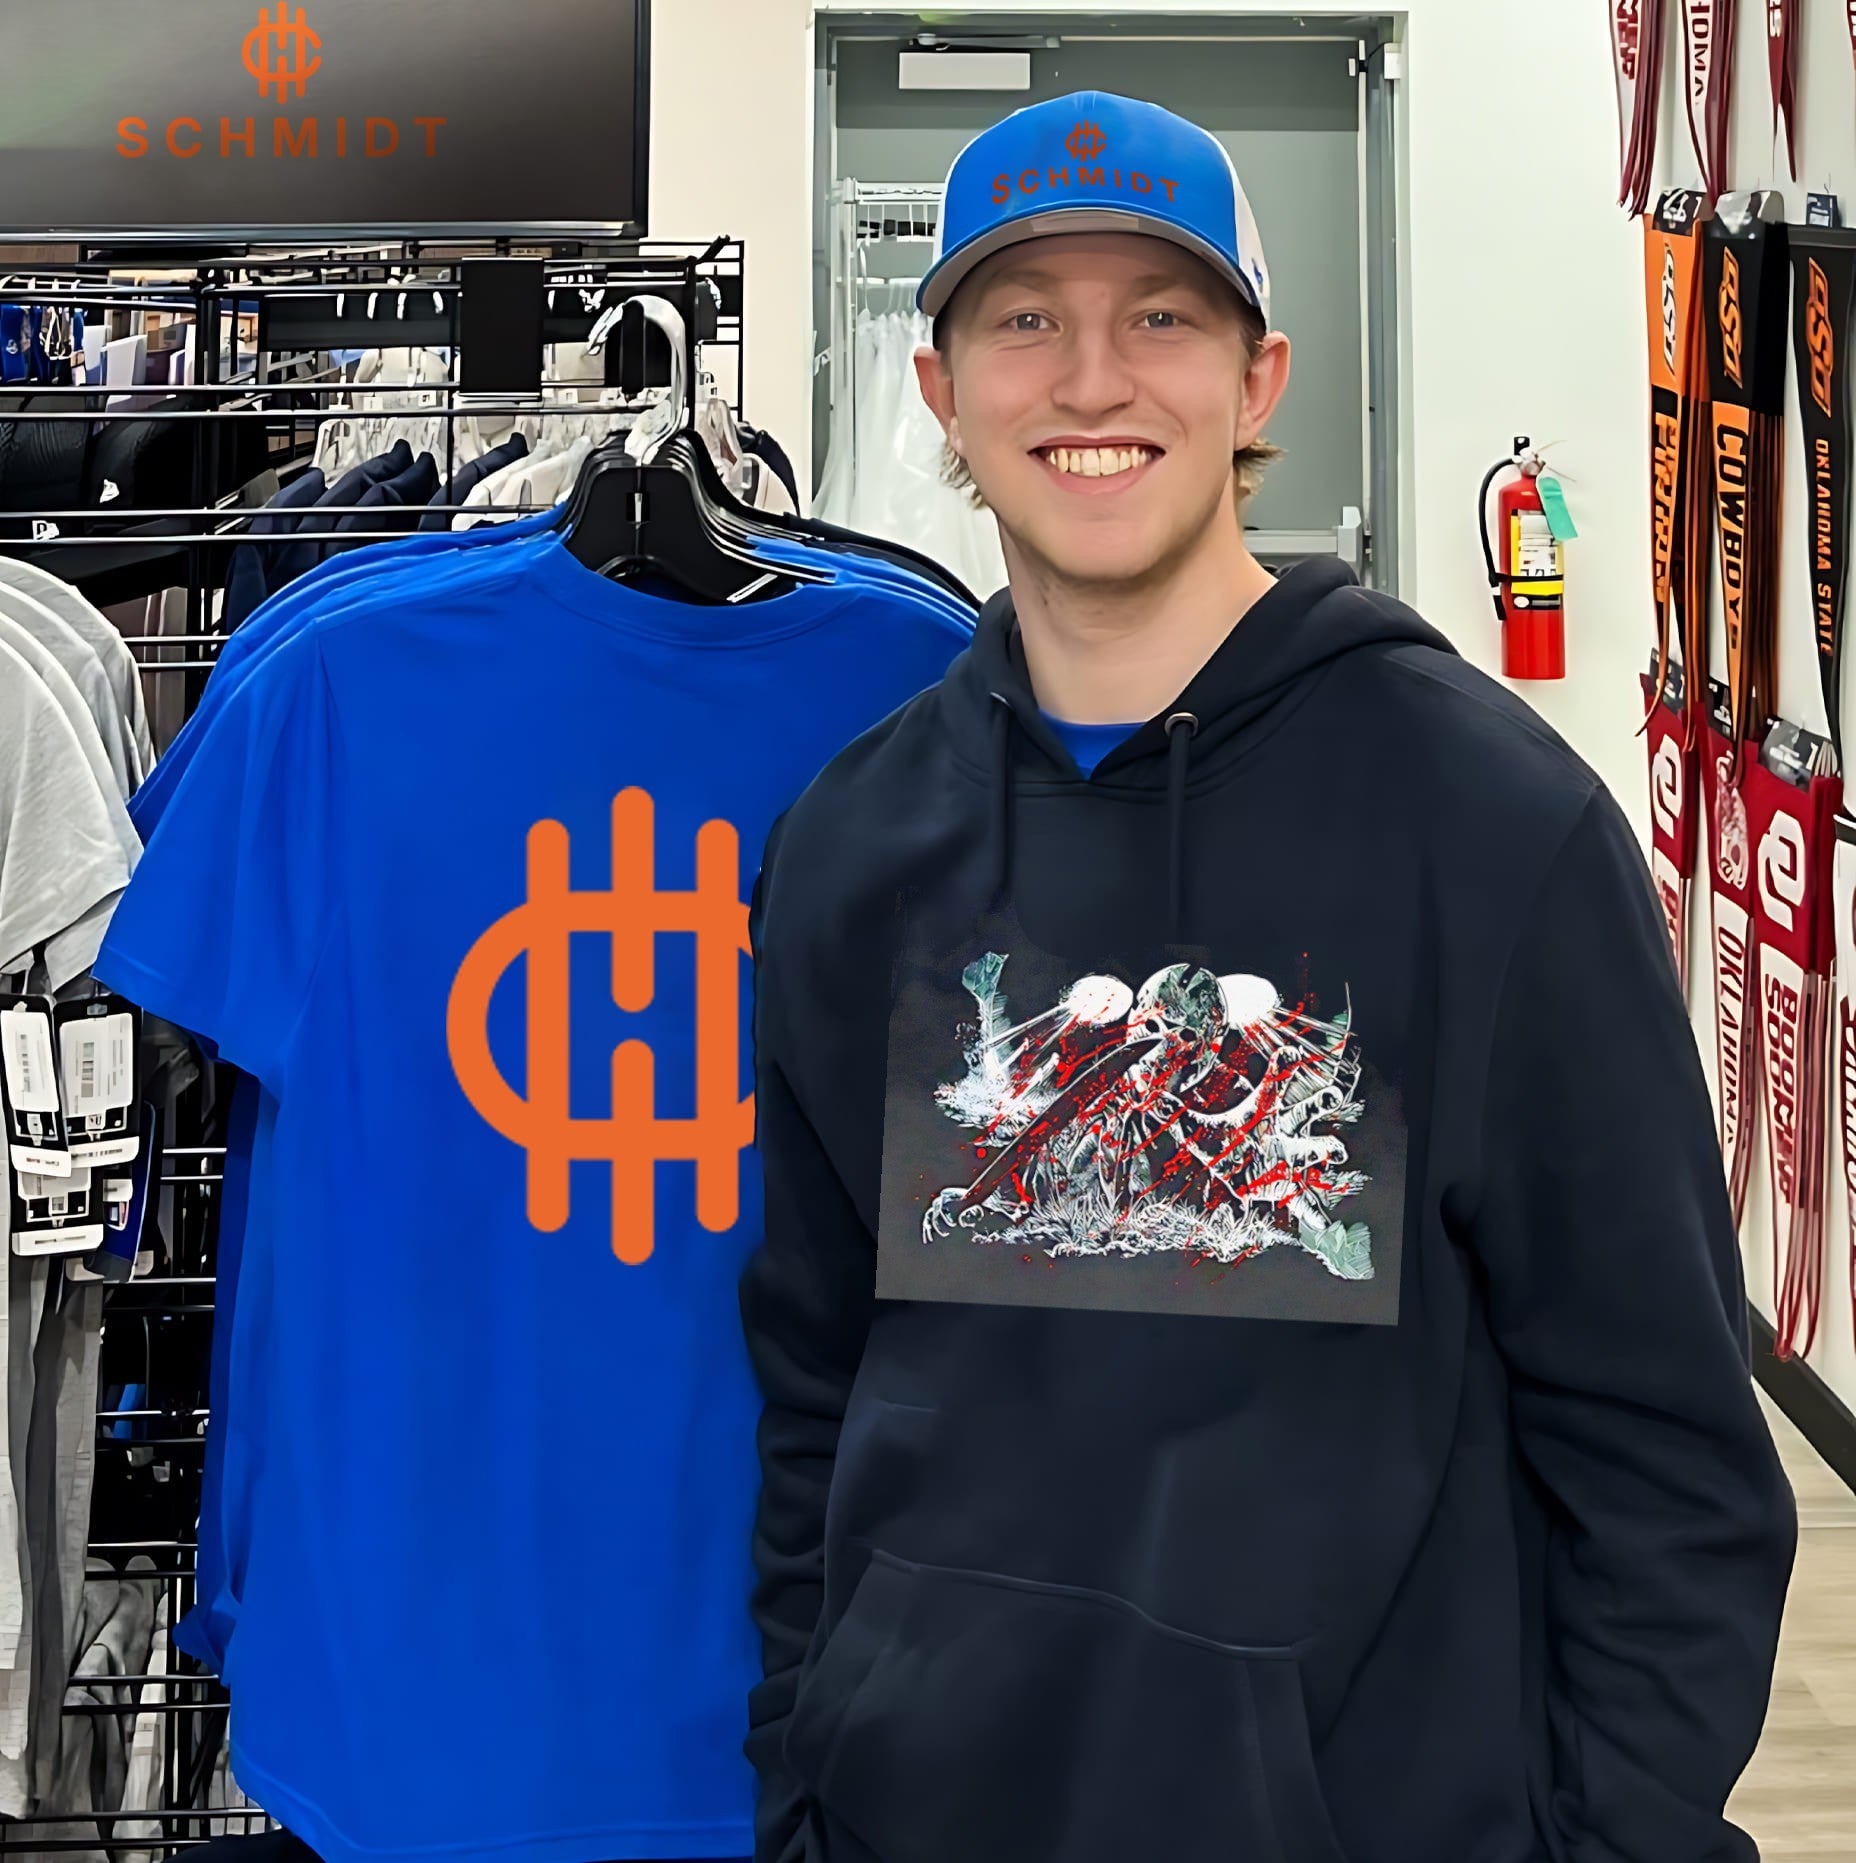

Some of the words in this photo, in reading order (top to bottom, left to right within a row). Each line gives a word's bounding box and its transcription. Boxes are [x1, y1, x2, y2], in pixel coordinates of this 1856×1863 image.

[116, 116, 448, 159] SCHMIDT
[991, 167, 1180, 204] SCHMIDT
[1815, 438, 1833, 570] OKLAHOMA
[1718, 926, 1745, 1144] OKLAHOMA
